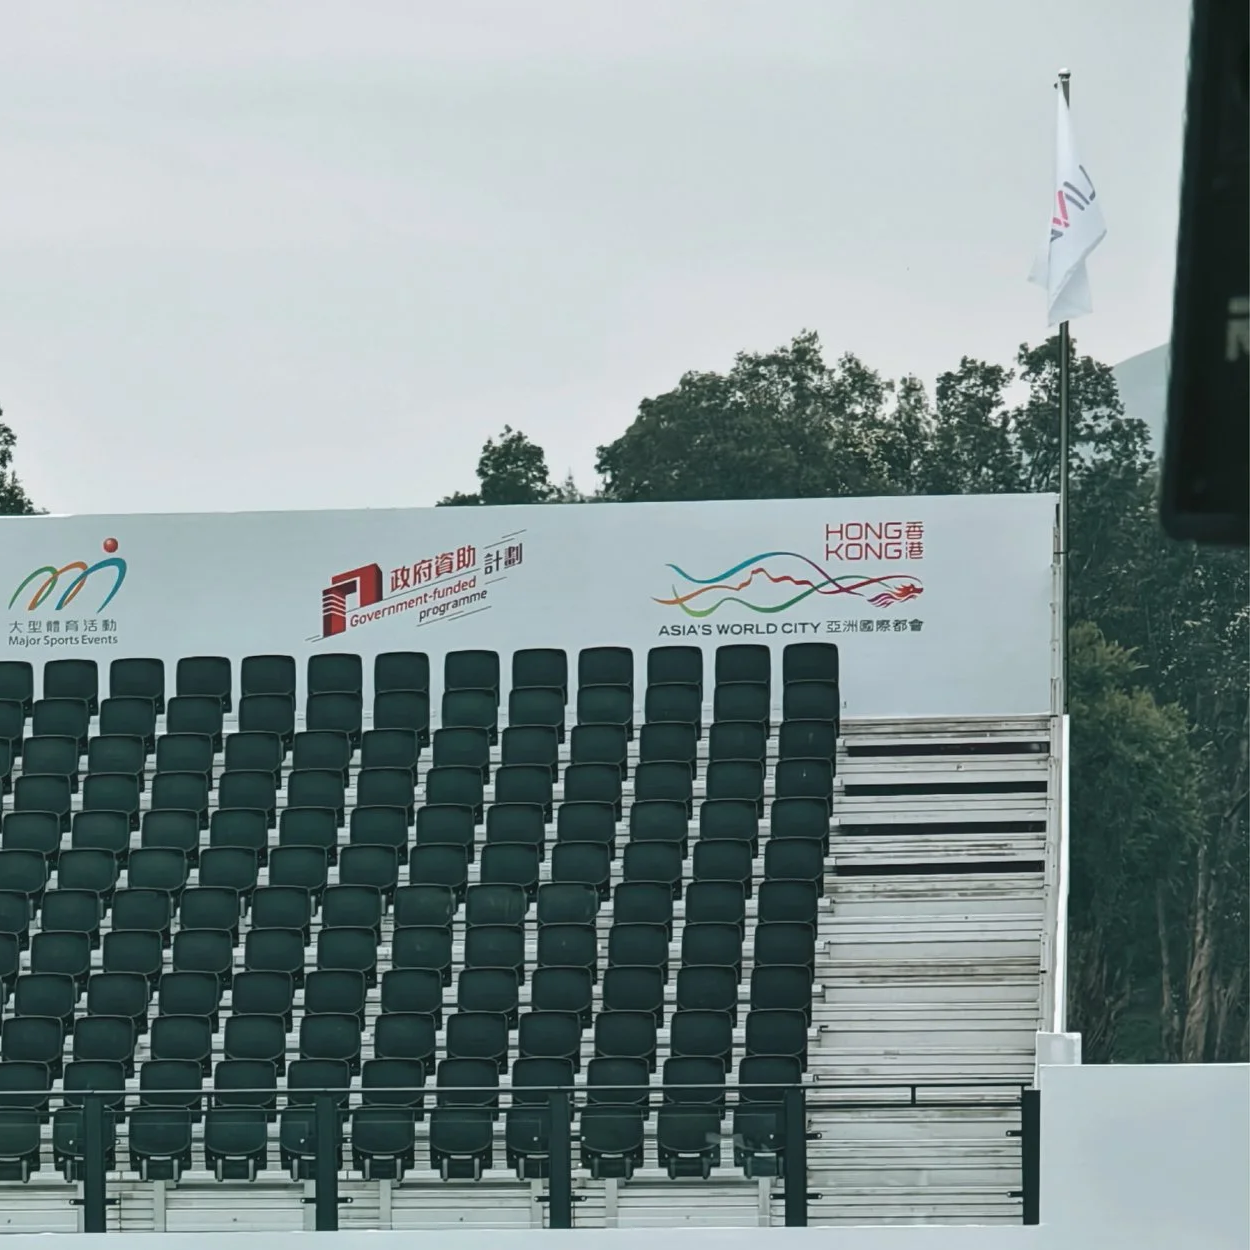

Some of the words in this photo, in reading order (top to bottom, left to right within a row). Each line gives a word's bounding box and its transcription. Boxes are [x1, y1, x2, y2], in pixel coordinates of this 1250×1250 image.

[825, 521, 902, 541] HONG
[825, 541, 902, 561] KONG
[350, 576, 477, 628] Government-funded
[419, 589, 488, 623] programme
[8, 619, 117, 634] 大型體育活動
[658, 622, 713, 637] ASIA'S
[716, 622, 778, 636] WORLD
[781, 621, 822, 635] CITY
[826, 618, 924, 634] 亞洲國際都會
[8, 635, 41, 648] Major
[43, 634, 79, 648] Sports
[81, 634, 118, 645] Events
